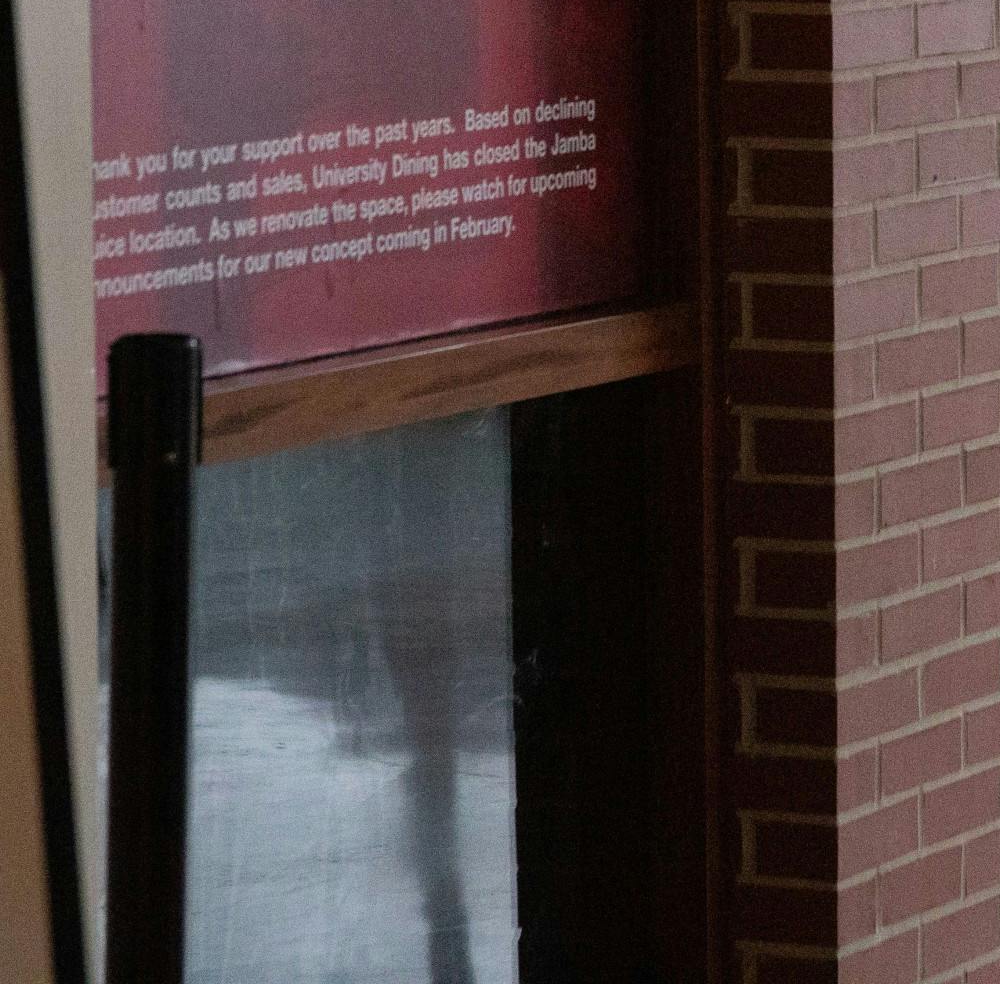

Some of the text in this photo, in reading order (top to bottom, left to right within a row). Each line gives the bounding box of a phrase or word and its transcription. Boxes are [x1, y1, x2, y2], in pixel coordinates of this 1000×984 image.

[136, 153, 168, 181] you
[172, 145, 196, 170] for
[200, 143, 237, 173] your
[241, 132, 304, 163] support
[307, 131, 341, 153] over
[346, 123, 370, 147] the
[374, 120, 407, 149] past
[412, 116, 455, 144] years.
[465, 105, 509, 132] Based
[513, 107, 530, 126] on
[535, 96, 596, 121] declining
[165, 183, 222, 211] counts
[227, 173, 257, 202] and
[312, 162, 387, 189] University
[392, 152, 439, 178] Dining
[443, 147, 468, 169] has
[473, 138, 520, 166] closed
[524, 135, 547, 159] the
[551, 129, 596, 156] Jamba
[129, 222, 200, 254] location.
[208, 217, 231, 242] As
[233, 218, 256, 238] we
[260, 203, 329, 234] renovate
[331, 199, 356, 223] the
[360, 194, 408, 224] space,
[411, 187, 458, 216] please
[462, 175, 504, 204] watch
[507, 174, 528, 196] for
[530, 165, 597, 198] upcoming
[217, 254, 241, 279] for
[244, 252, 272, 274] our
[275, 246, 308, 269] new
[311, 233, 373, 262] concept
[375, 224, 430, 252] coming
[434, 220, 447, 244] in
[451, 215, 515, 239] February.
